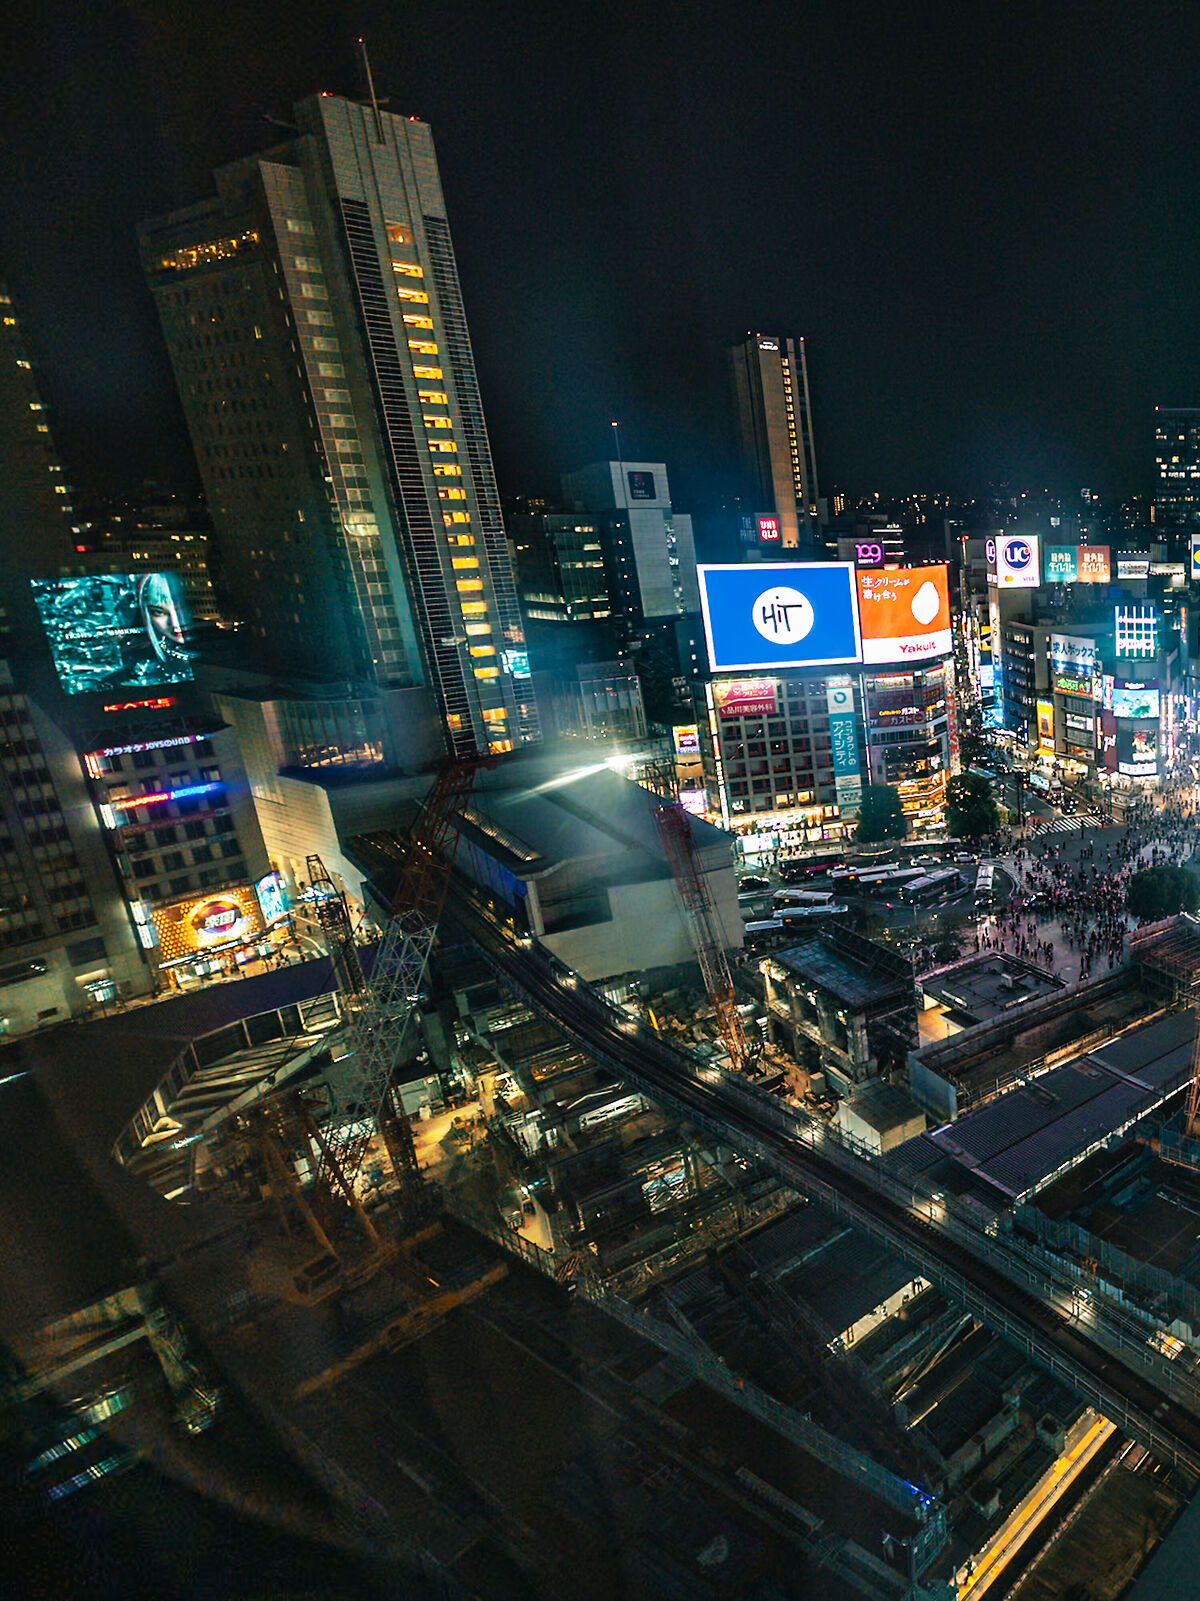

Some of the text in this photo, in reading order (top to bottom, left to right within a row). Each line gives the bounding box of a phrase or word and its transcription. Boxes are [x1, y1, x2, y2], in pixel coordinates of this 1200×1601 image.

[760, 520, 776, 530] UNI
[761, 529, 778, 540] QLO
[855, 544, 882, 563] 109
[899, 641, 936, 653] Yakult
[104, 698, 172, 712] KATE
[104, 736, 191, 757] カラオケ JOYSOUND
[832, 720, 847, 766] アイシティ
